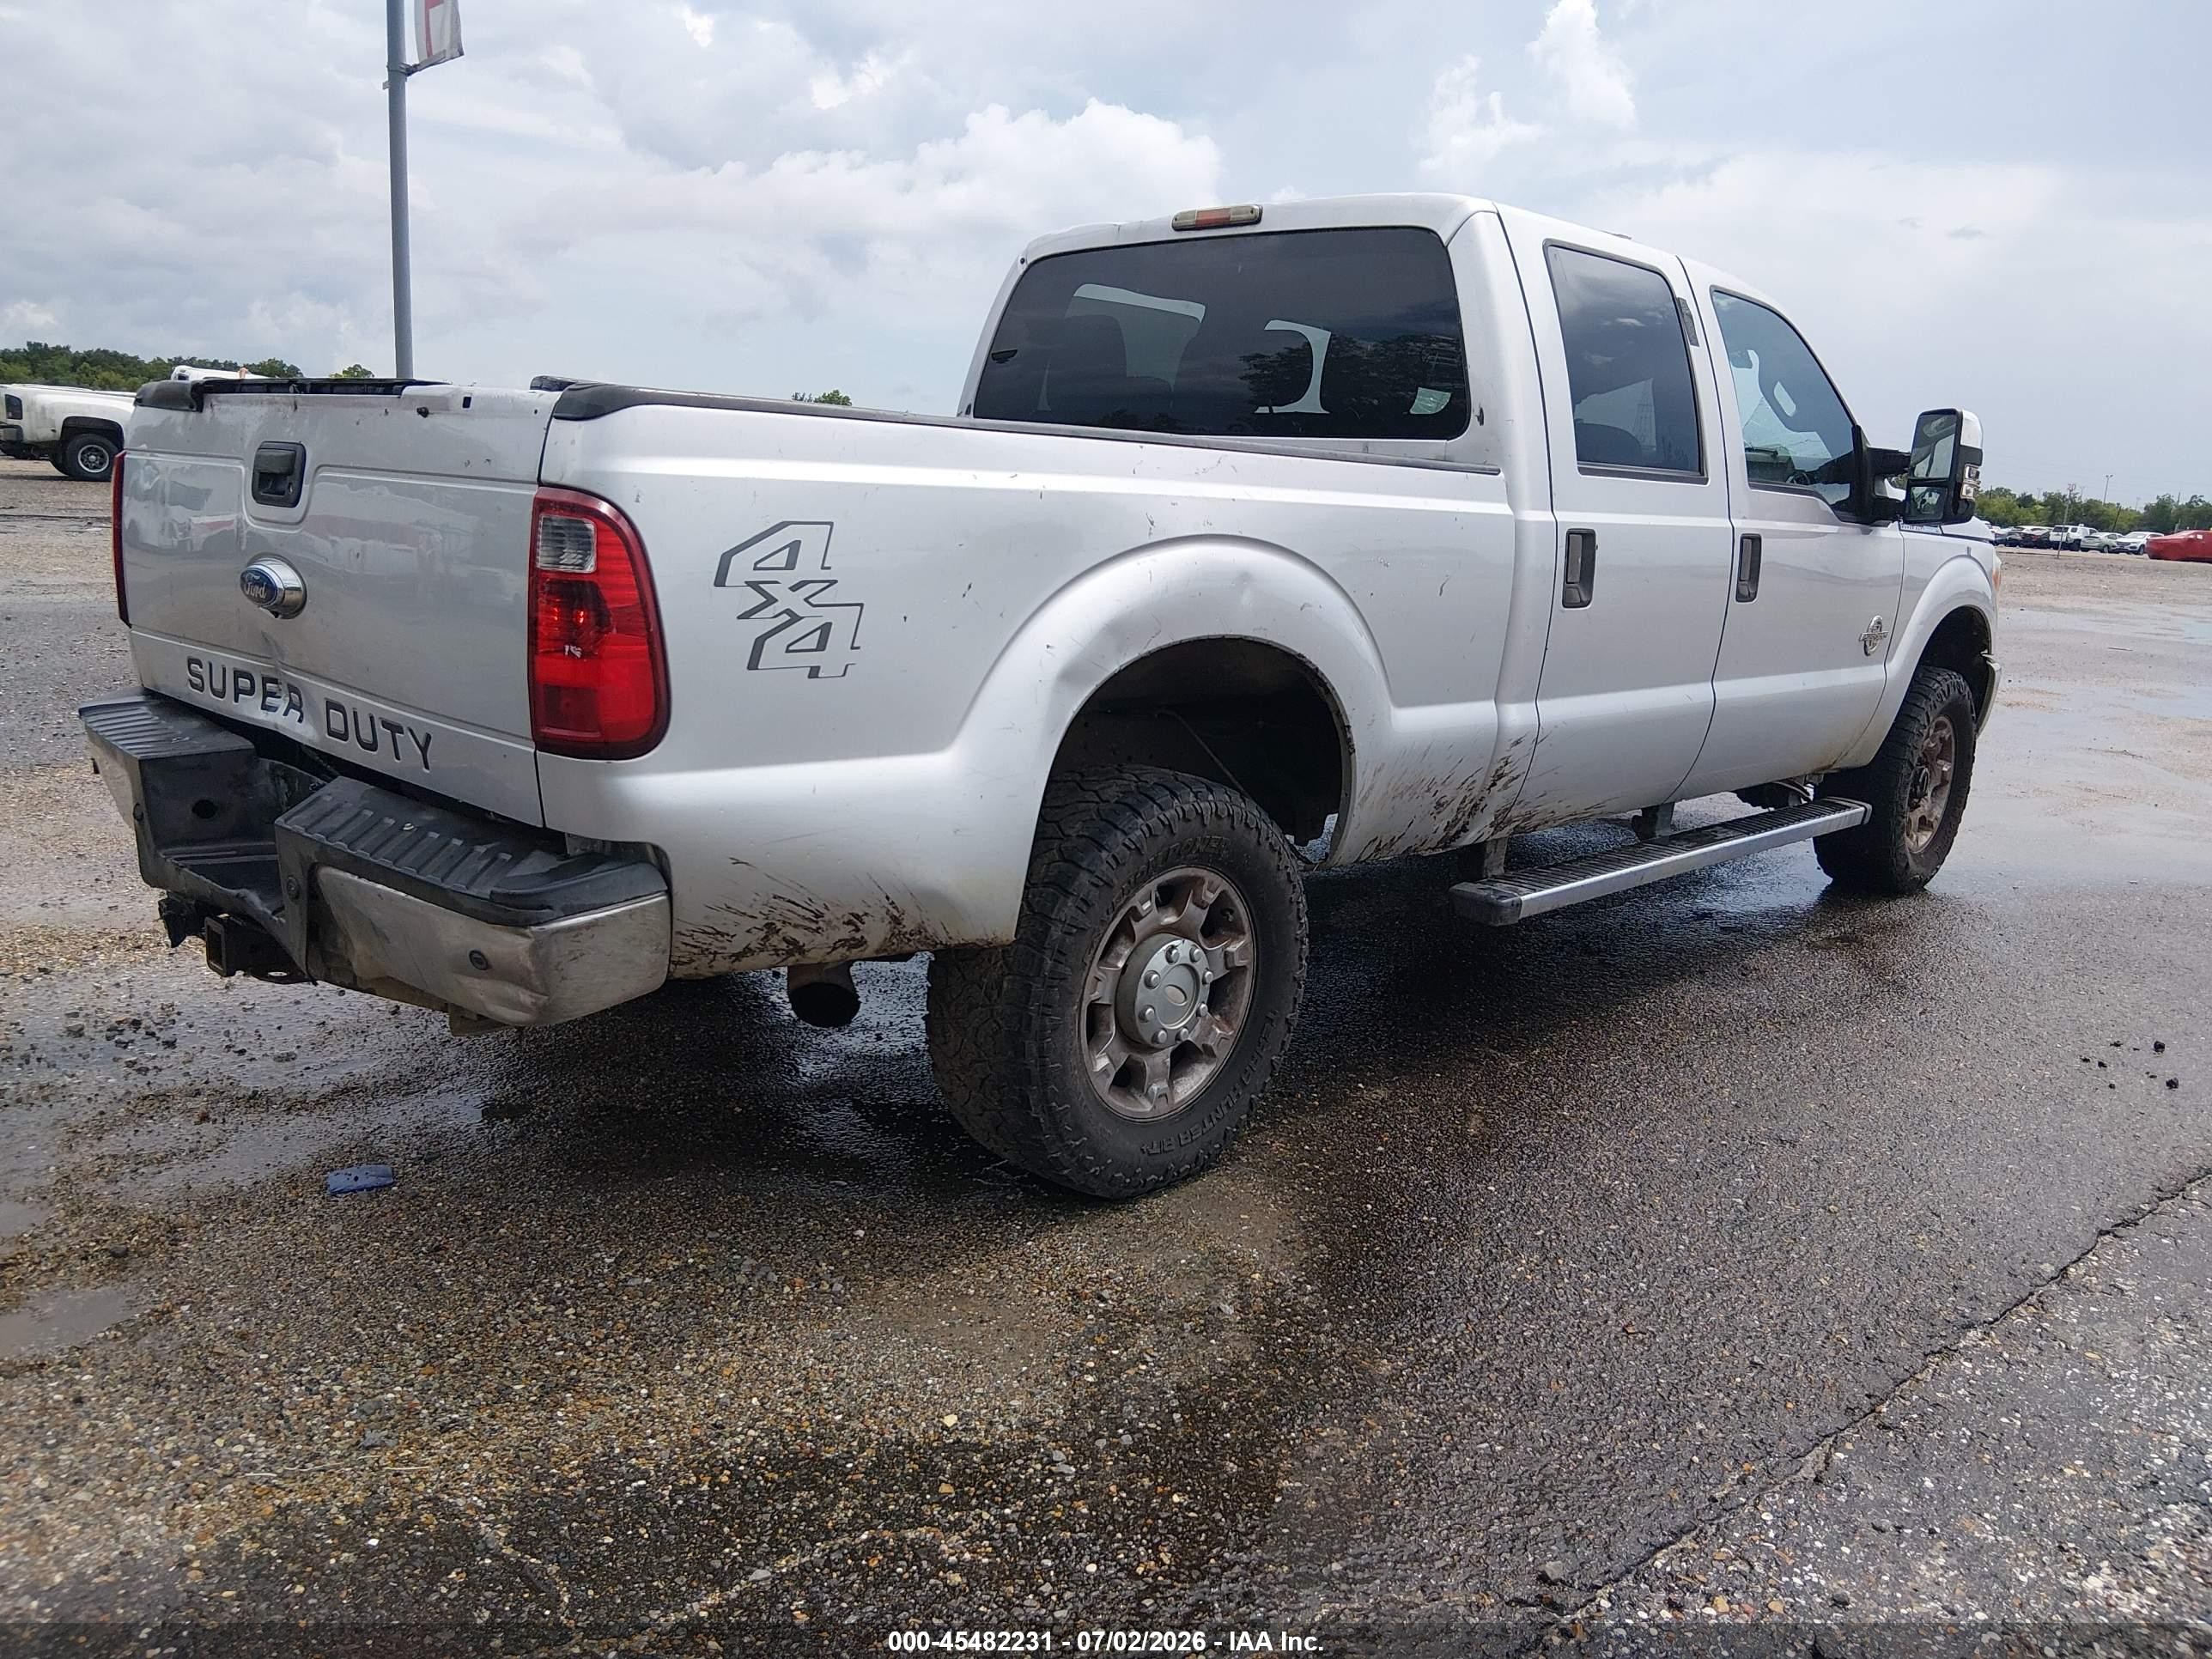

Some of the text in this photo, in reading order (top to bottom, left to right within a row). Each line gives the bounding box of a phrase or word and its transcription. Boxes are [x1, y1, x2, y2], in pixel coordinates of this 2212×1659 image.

[244, 572, 267, 599] Ford
[186, 657, 432, 772] SUPER DUTY
[1178, 1084, 1243, 1146] HUNTER
